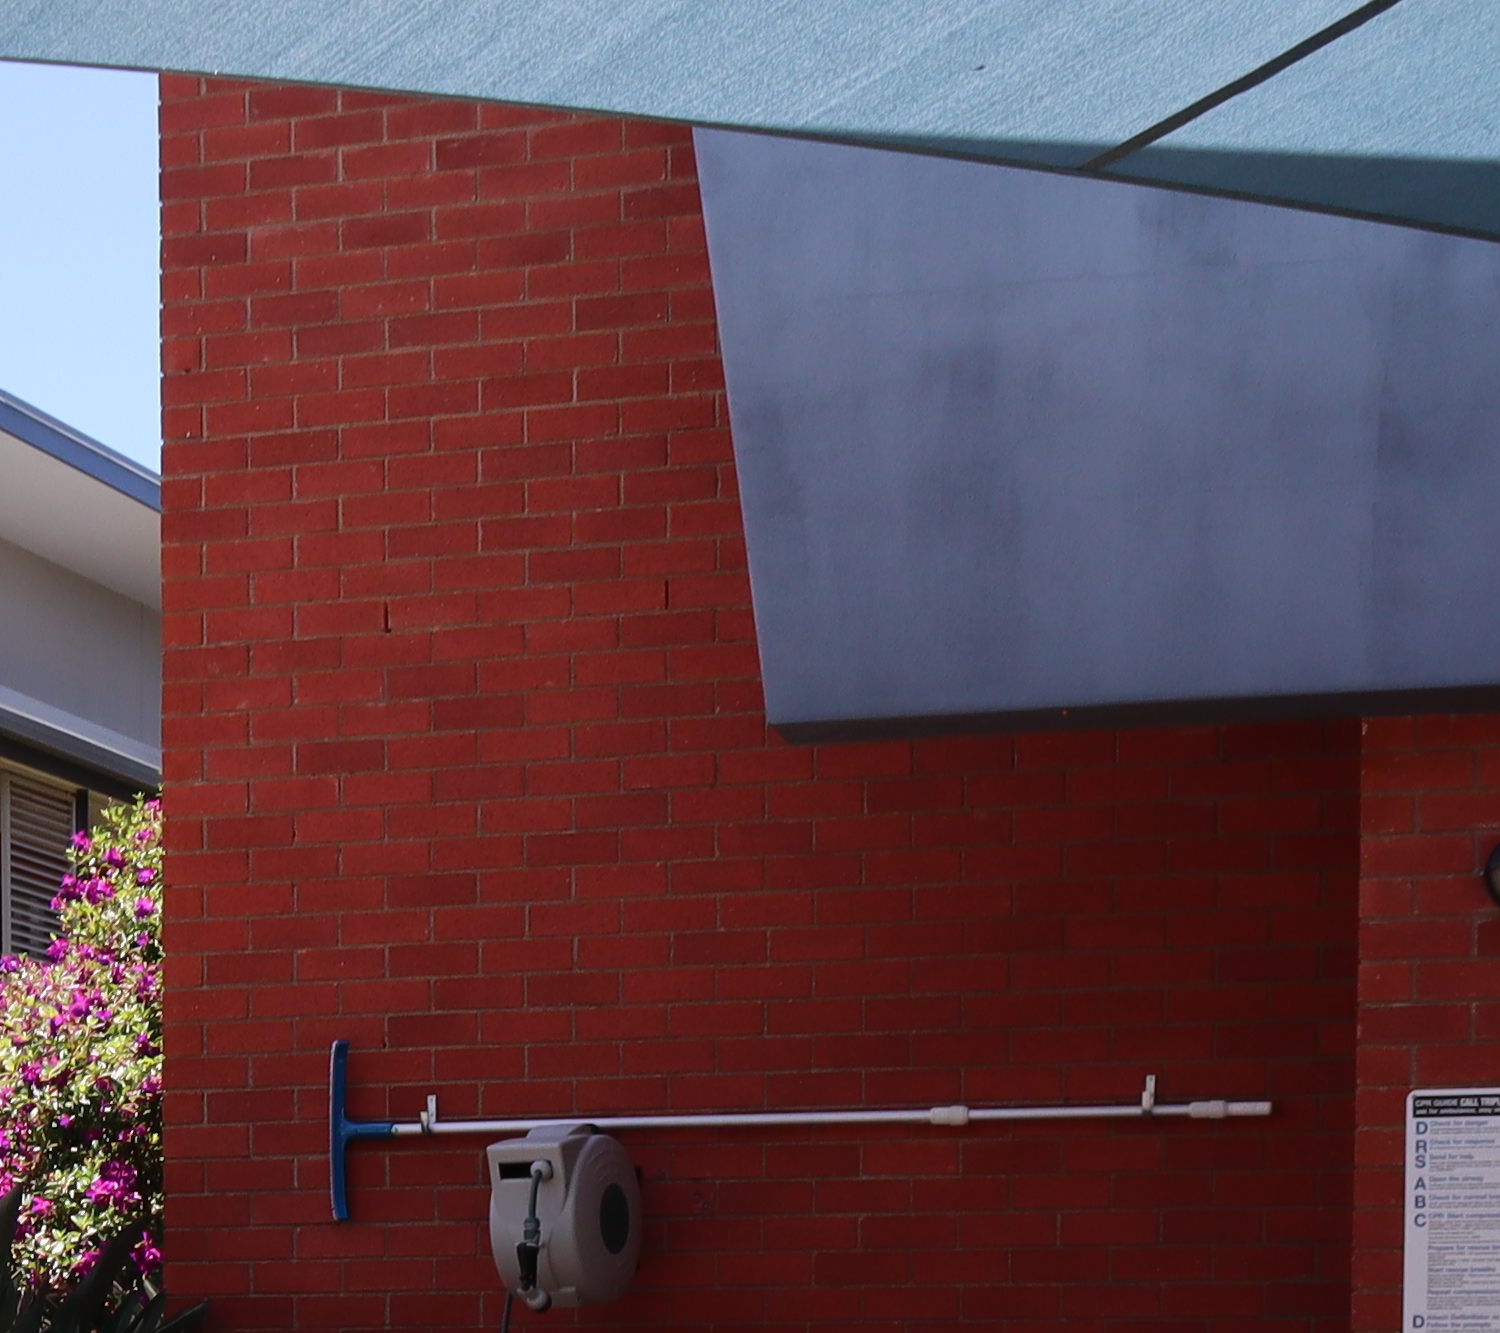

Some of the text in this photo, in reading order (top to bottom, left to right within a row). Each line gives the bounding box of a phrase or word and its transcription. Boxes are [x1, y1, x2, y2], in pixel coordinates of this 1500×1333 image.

[1416, 1121, 1428, 1135] D
[1415, 1140, 1427, 1154] R
[1415, 1155, 1427, 1168] S
[1414, 1177, 1426, 1190] A
[1415, 1195, 1426, 1209] B
[1414, 1214, 1427, 1227] C
[1413, 1315, 1425, 1328] D
